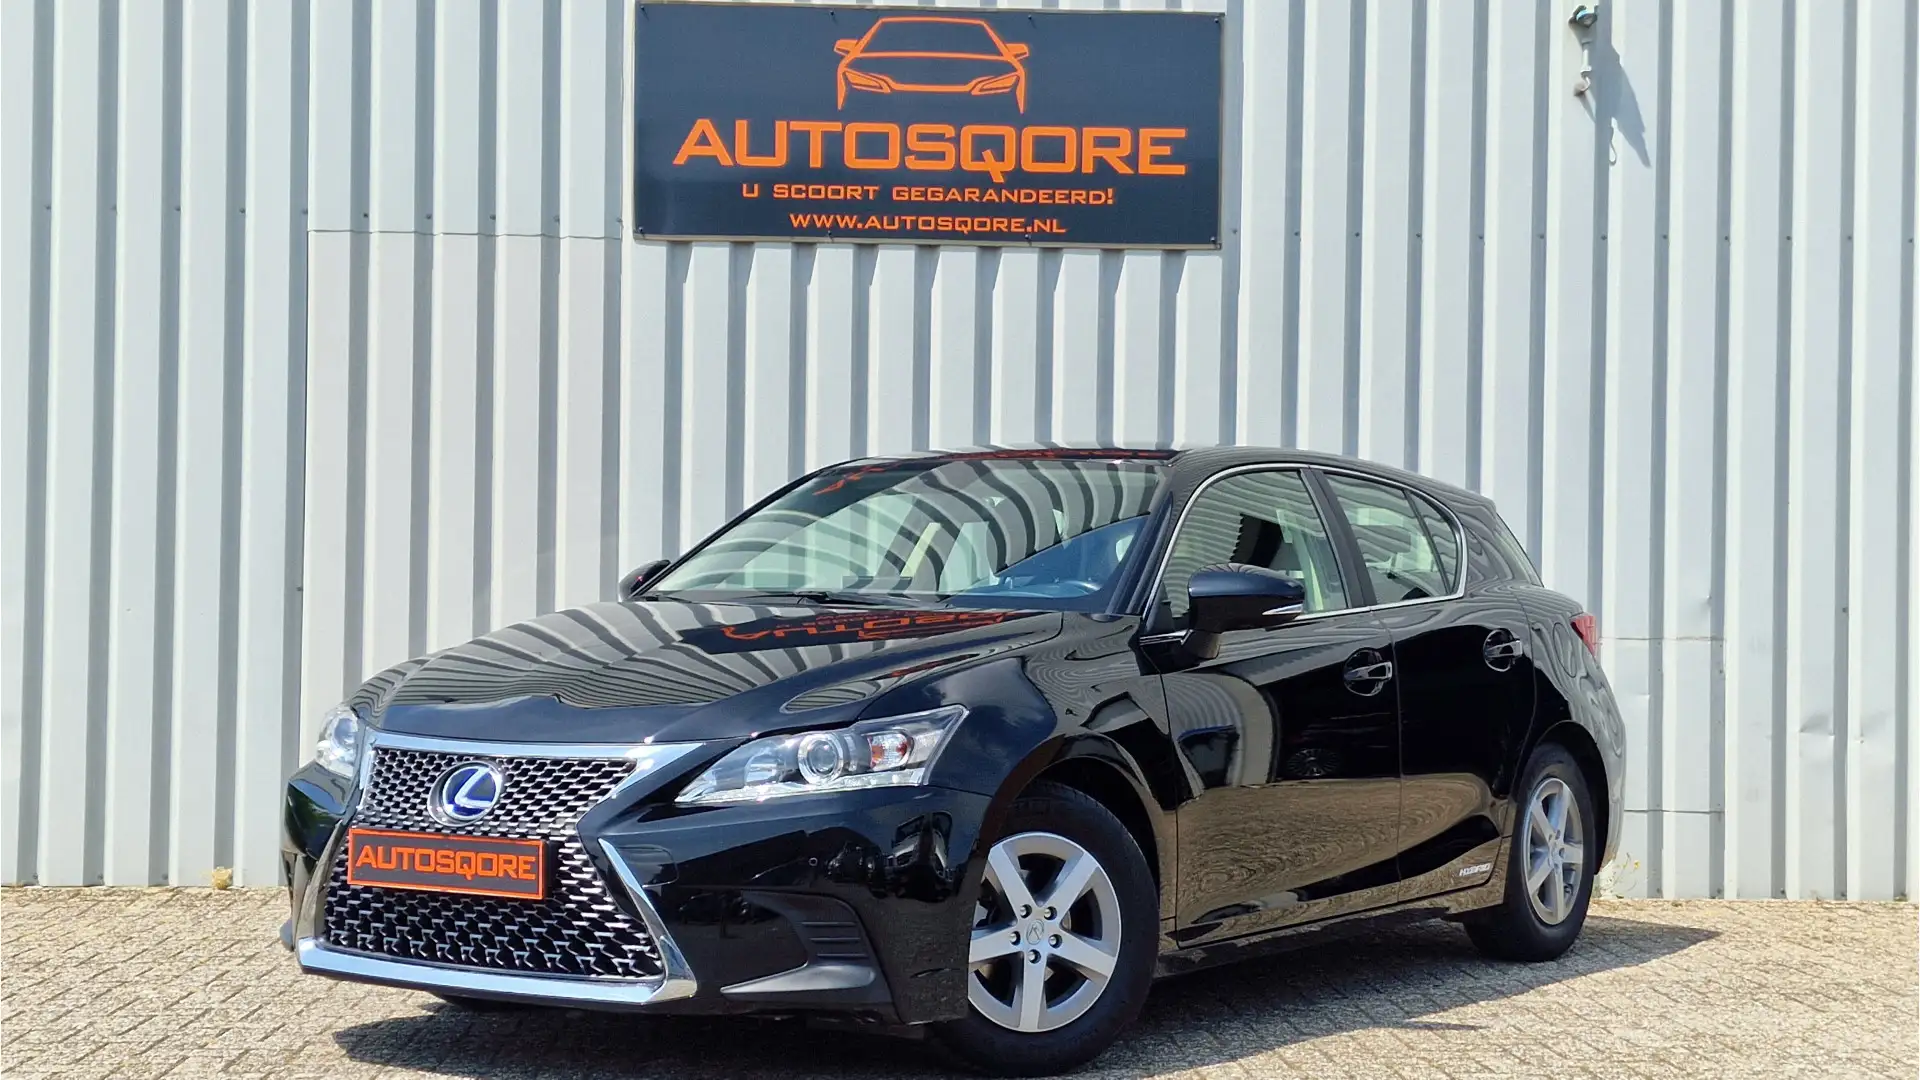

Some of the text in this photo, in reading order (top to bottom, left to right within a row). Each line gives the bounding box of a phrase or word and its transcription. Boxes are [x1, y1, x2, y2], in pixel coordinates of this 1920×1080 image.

[673, 118, 1187, 184] AUTOSQORE
[742, 183, 1114, 206] U SCOORT GEGARANDEERD!
[790, 214, 1067, 235] WWW.AUTOSQORE.NL
[355, 845, 537, 880] AUTOSQORE
